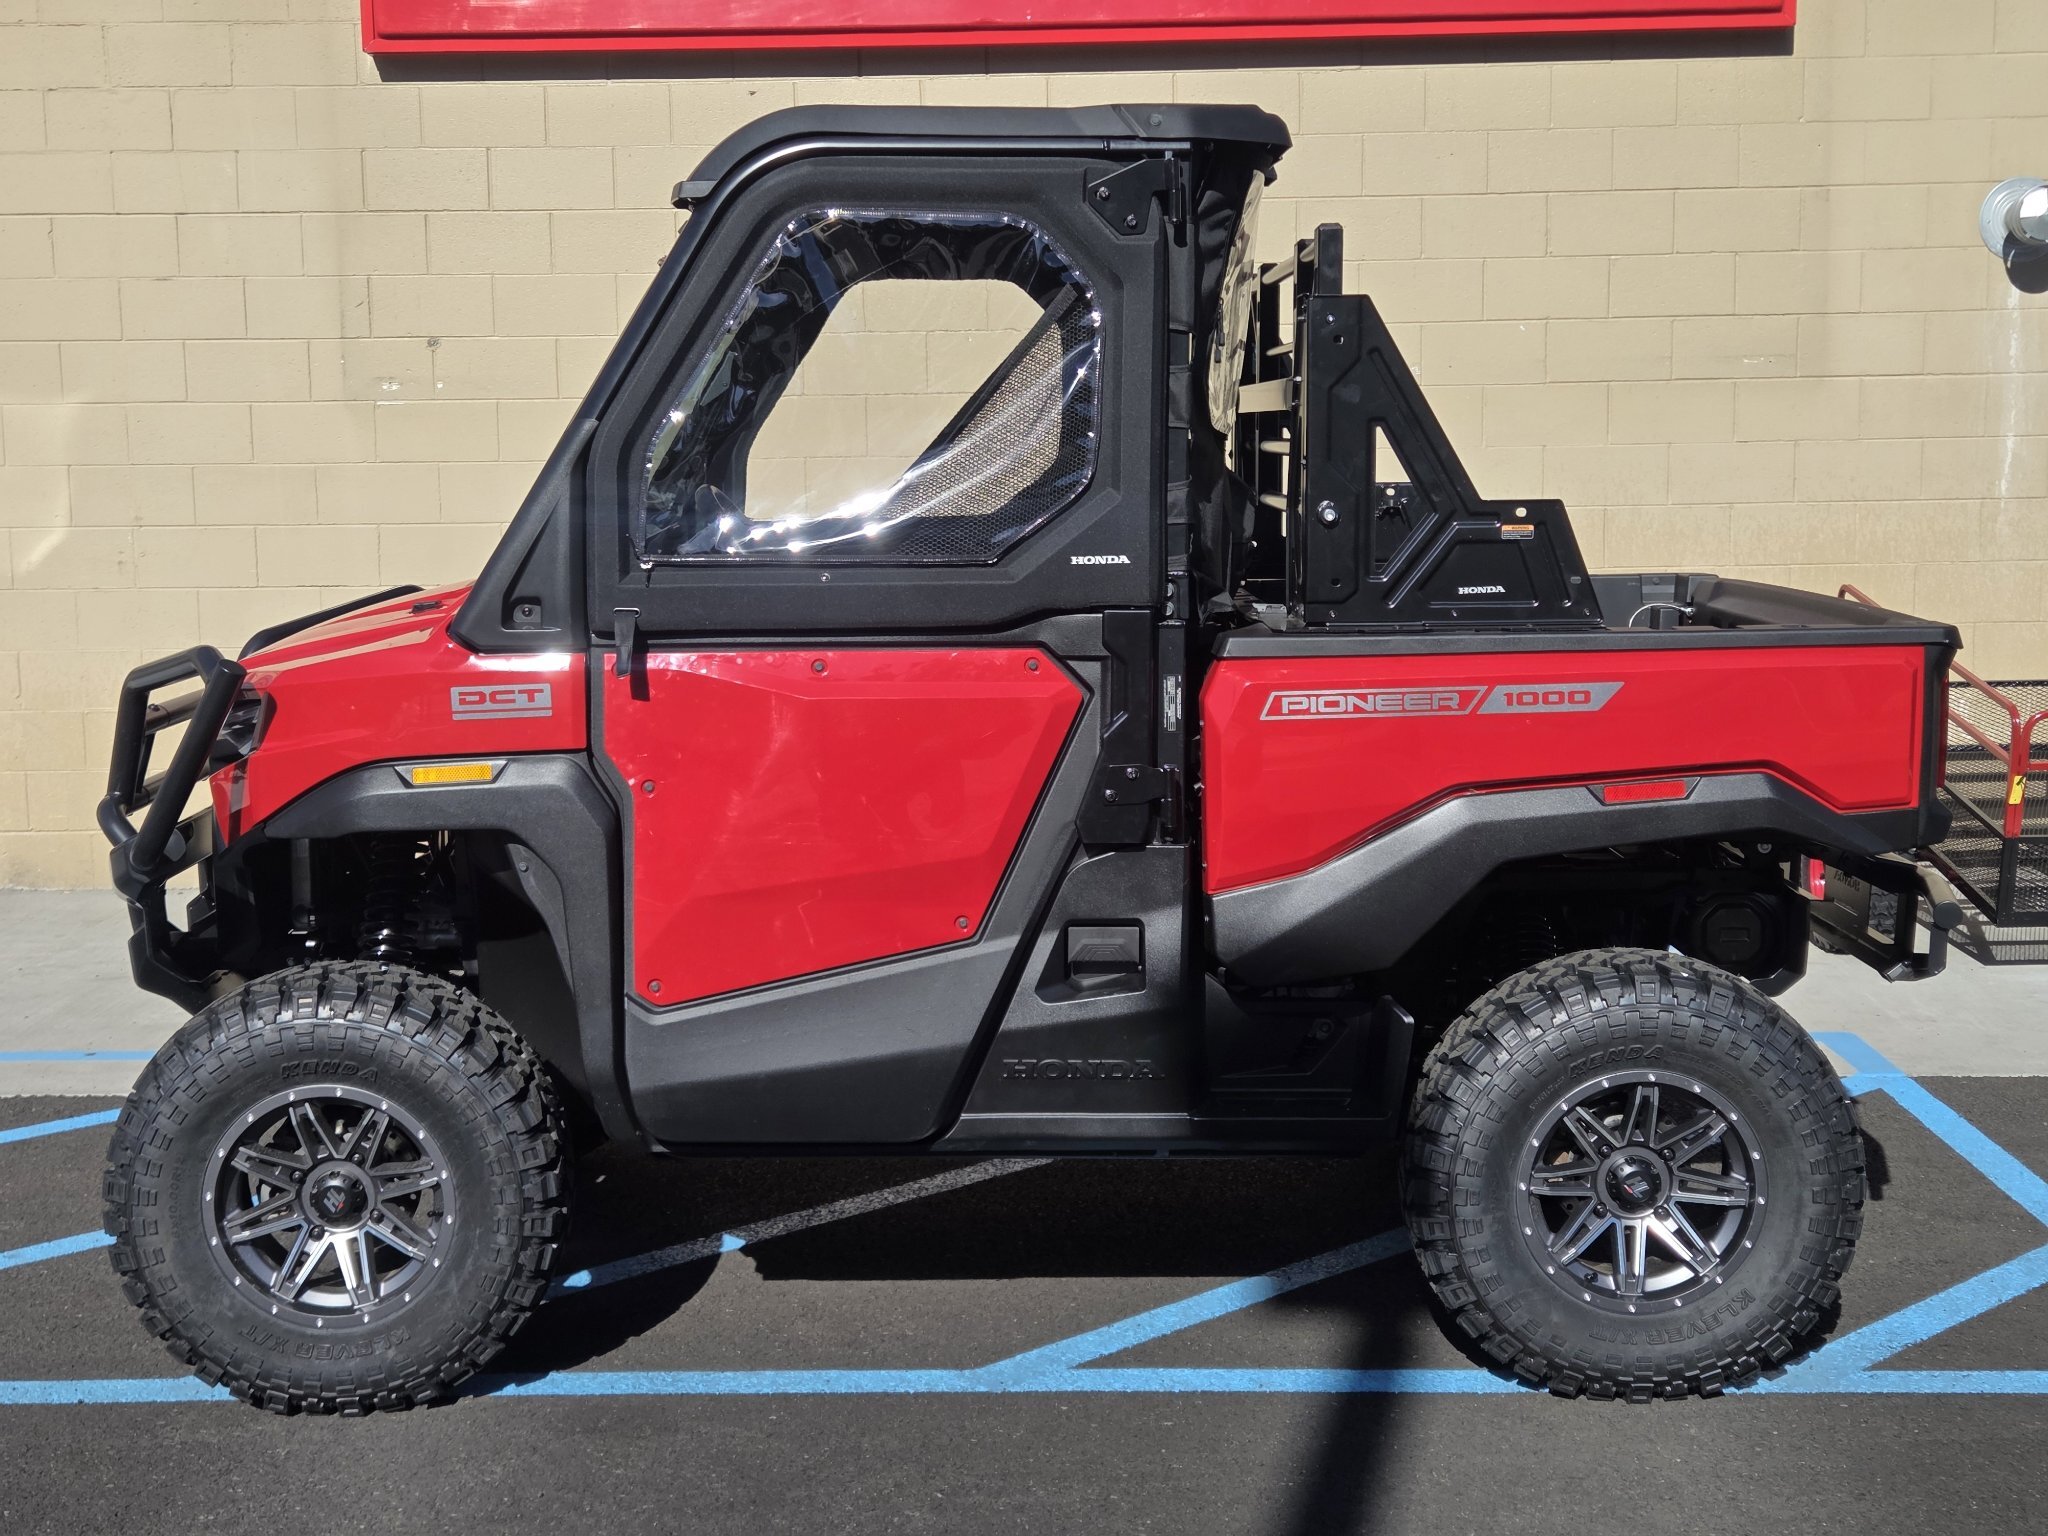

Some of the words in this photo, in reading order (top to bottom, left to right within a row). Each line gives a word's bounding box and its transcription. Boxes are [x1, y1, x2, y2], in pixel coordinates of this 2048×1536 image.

[1070, 555, 1131, 566] HONDA
[1457, 585, 1506, 595] HONDA
[457, 688, 545, 706] DCT
[1281, 691, 1461, 714] PIONEER
[1503, 690, 1592, 708] 1000
[280, 1061, 380, 1085] KENDA
[1001, 1058, 1165, 1081] HONDA
[1568, 1044, 1666, 1080] KENDA
[1644, 1286, 1756, 1346] KLEVER
[295, 1328, 411, 1360] KLEVER
